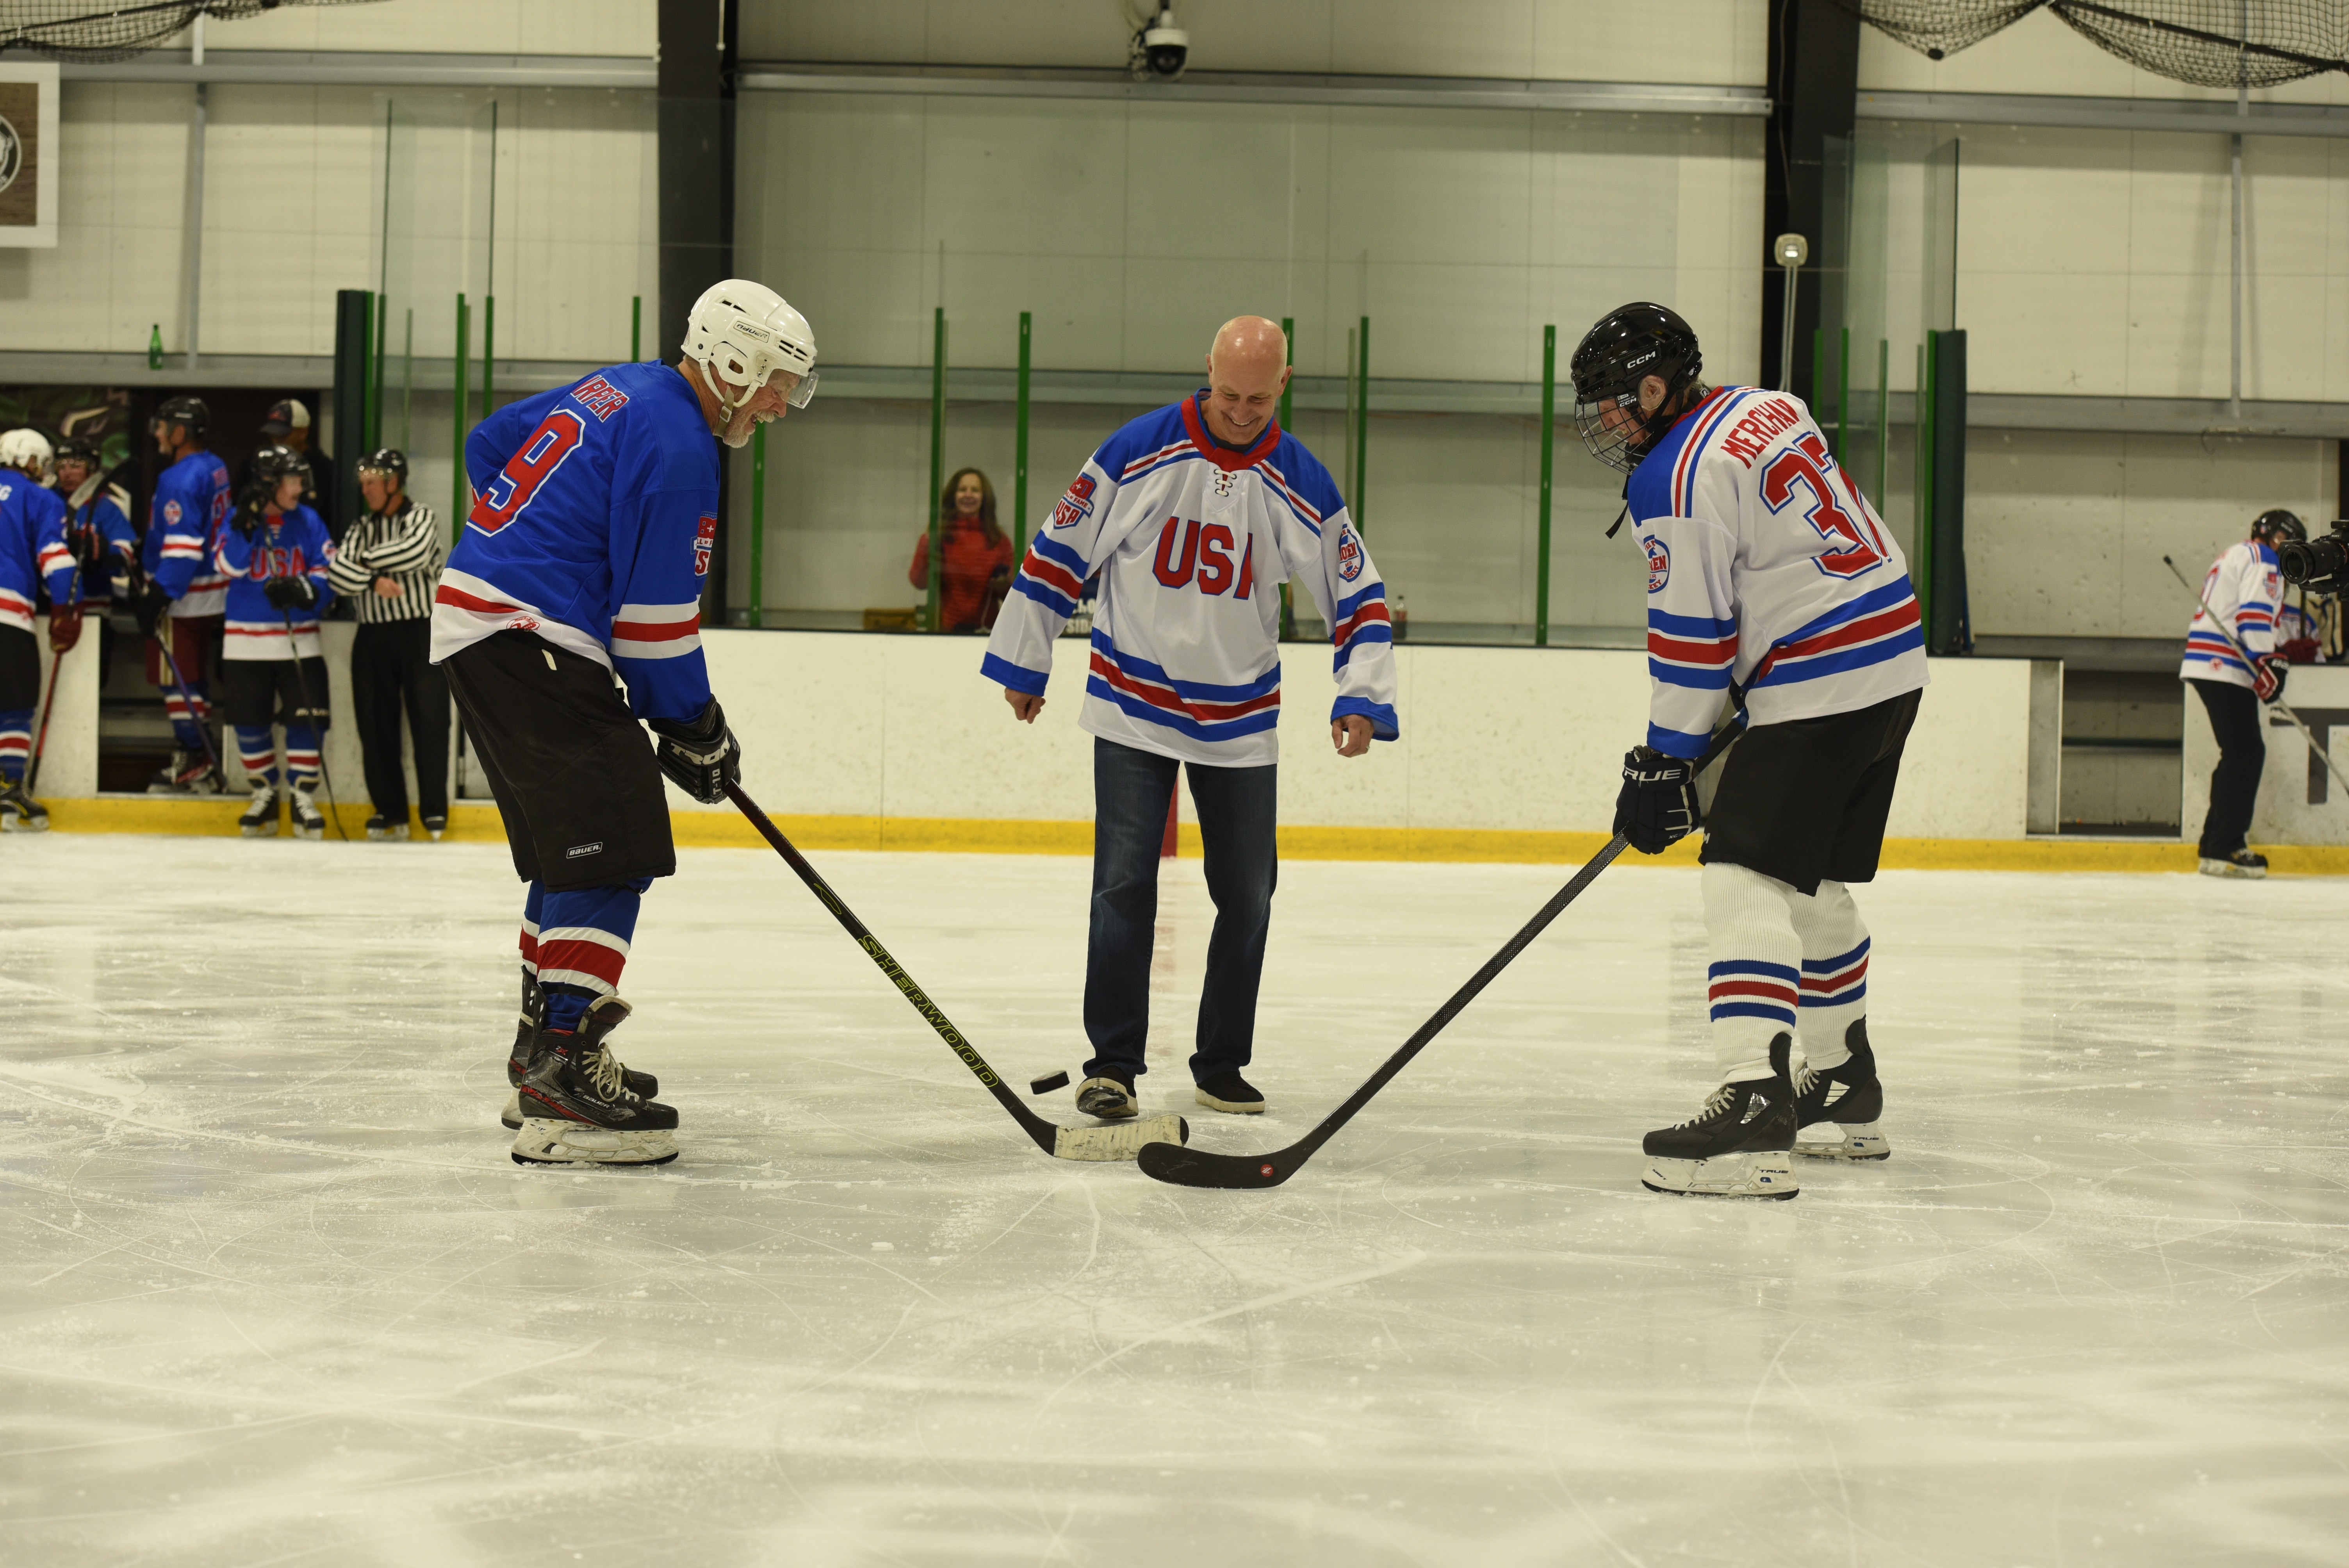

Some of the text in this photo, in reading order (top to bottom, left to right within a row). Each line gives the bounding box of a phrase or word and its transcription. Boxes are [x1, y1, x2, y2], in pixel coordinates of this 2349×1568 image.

[1627, 351, 1656, 369] CCM
[1620, 397, 1637, 407] CCM
[1073, 497, 1089, 508] FAME
[1055, 500, 1080, 525] USA
[249, 546, 307, 581] USA
[1624, 767, 1682, 781] RUE
[857, 934, 999, 1088] SHERWOOD
[1652, 1169, 1667, 1180] SHIFT
